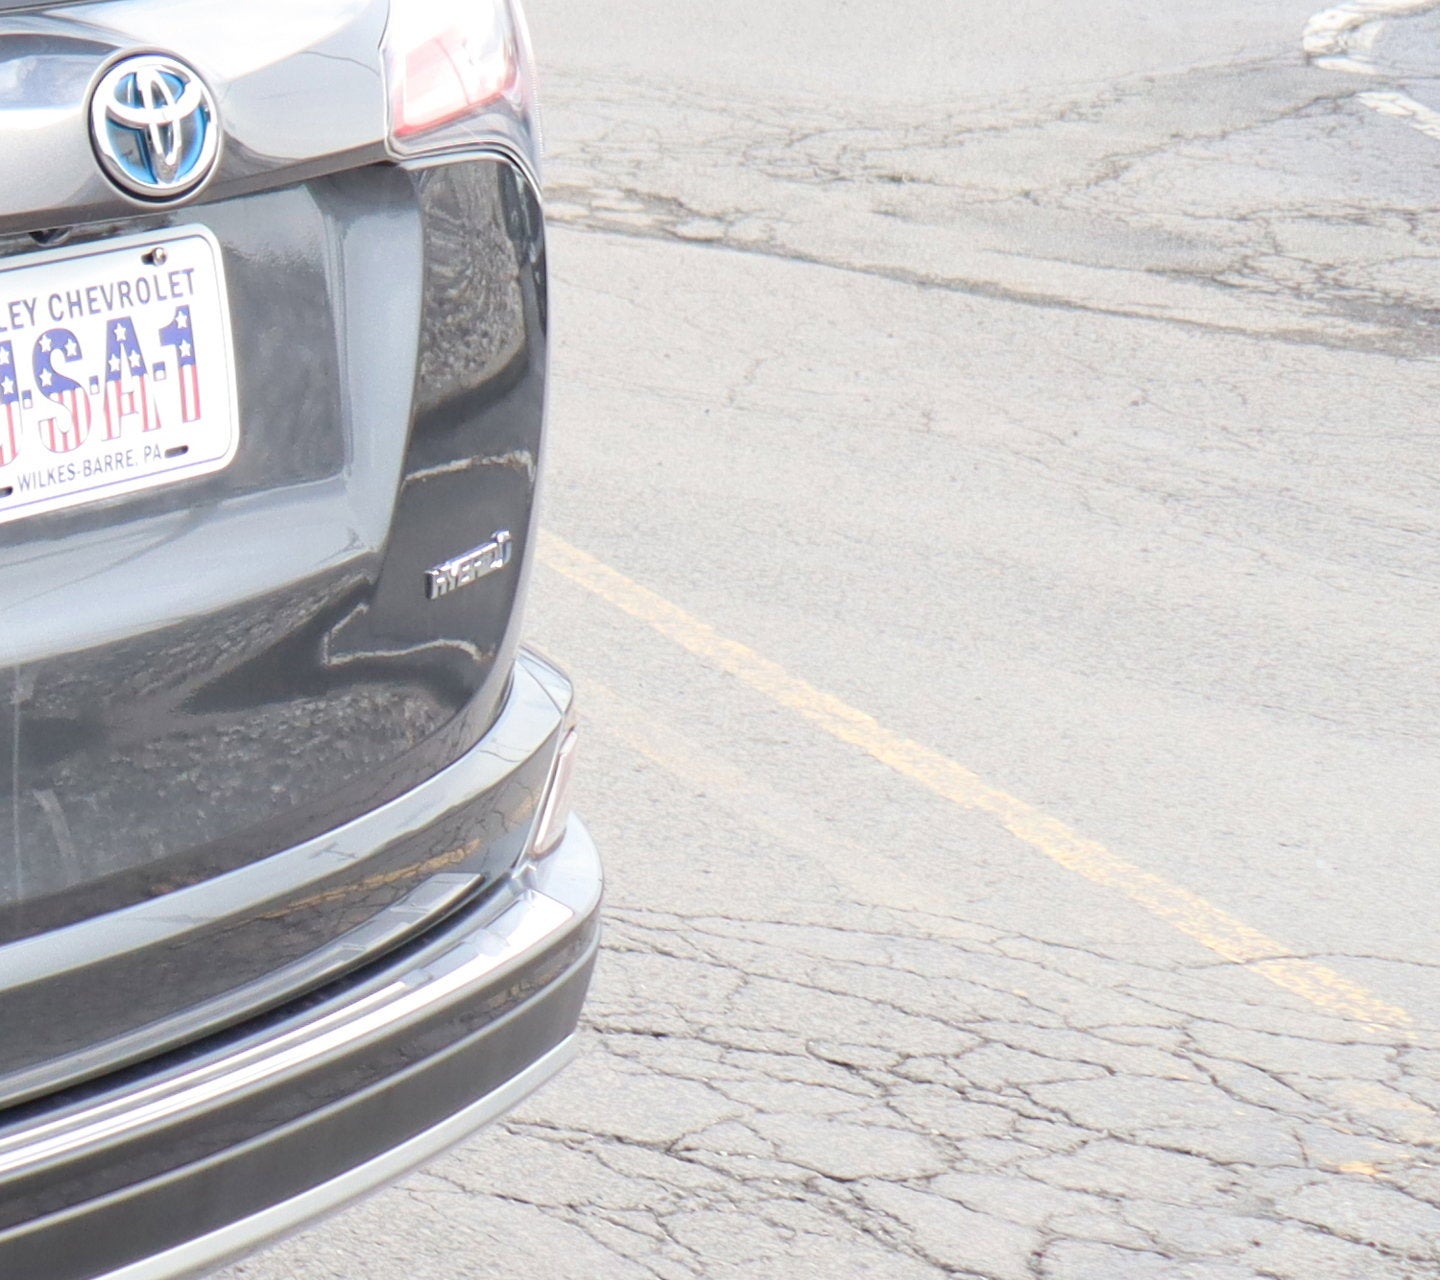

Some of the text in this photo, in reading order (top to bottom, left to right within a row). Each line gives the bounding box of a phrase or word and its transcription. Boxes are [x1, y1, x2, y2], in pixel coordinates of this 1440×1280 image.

[47, 267, 196, 323] CHEVROLET
[17, 443, 163, 493] WILKES-BARRE, PA
